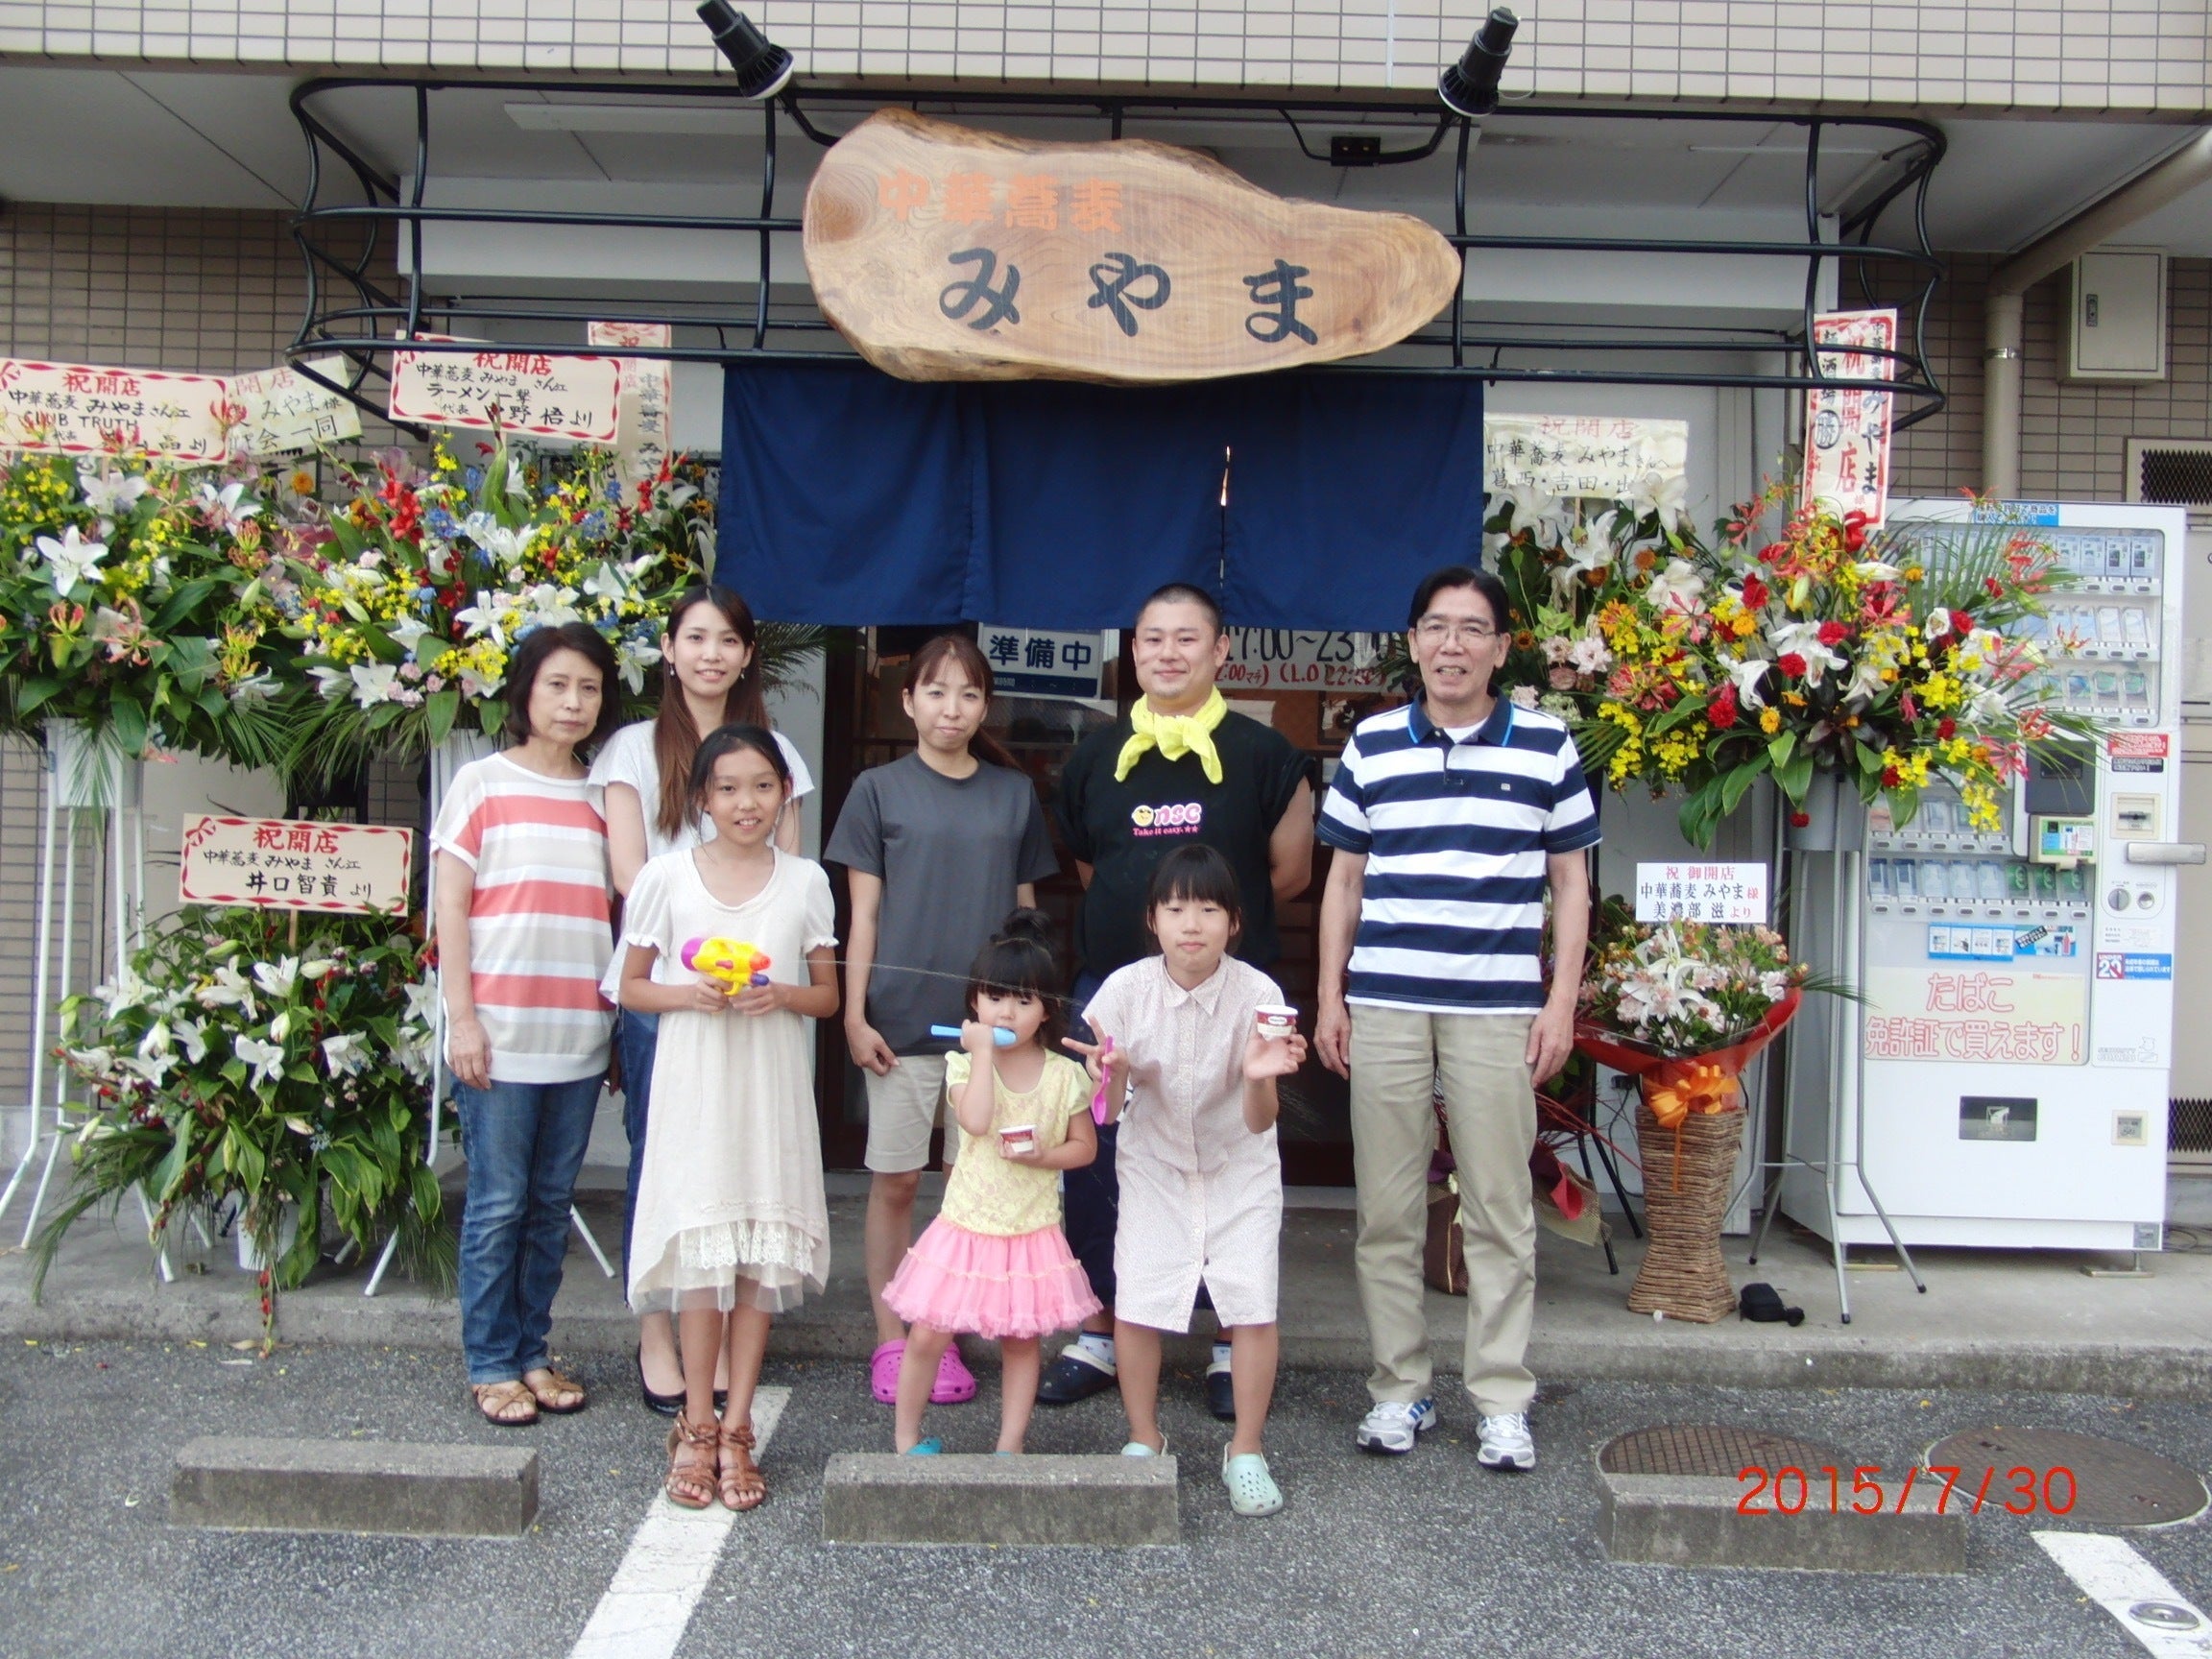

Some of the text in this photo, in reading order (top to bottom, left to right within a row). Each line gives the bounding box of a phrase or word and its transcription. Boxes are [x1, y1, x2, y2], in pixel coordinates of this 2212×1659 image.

[878, 169, 1123, 233] 中華蕎麦
[939, 247, 1318, 345] みやま
[417, 362, 474, 383] 中華蕎麦
[473, 353, 552, 375] 祝開店
[63, 373, 141, 397] 祝開店
[8, 389, 79, 411] 中華蕎麦
[86, 398, 145, 417] みやま
[261, 391, 319, 421] みやま
[78, 416, 138, 431] TRUTH
[1540, 416, 1635, 439] 祝開店
[1487, 439, 1568, 467] 中華蕎麦
[1577, 446, 1630, 468] みやま
[989, 635, 1092, 671] 準備中
[253, 827, 340, 854] 祝開店
[203, 849, 260, 867] 中華蕎麦
[265, 854, 313, 871] みやま
[1666, 865, 1736, 880] 祝 御開店
[349, 882, 372, 898] より
[1641, 882, 1759, 900] 中華蕎麦 みやま 様
[1730, 906, 1751, 918] より
[2098, 959, 2123, 977] 20
[1926, 972, 2015, 1013] たばこ
